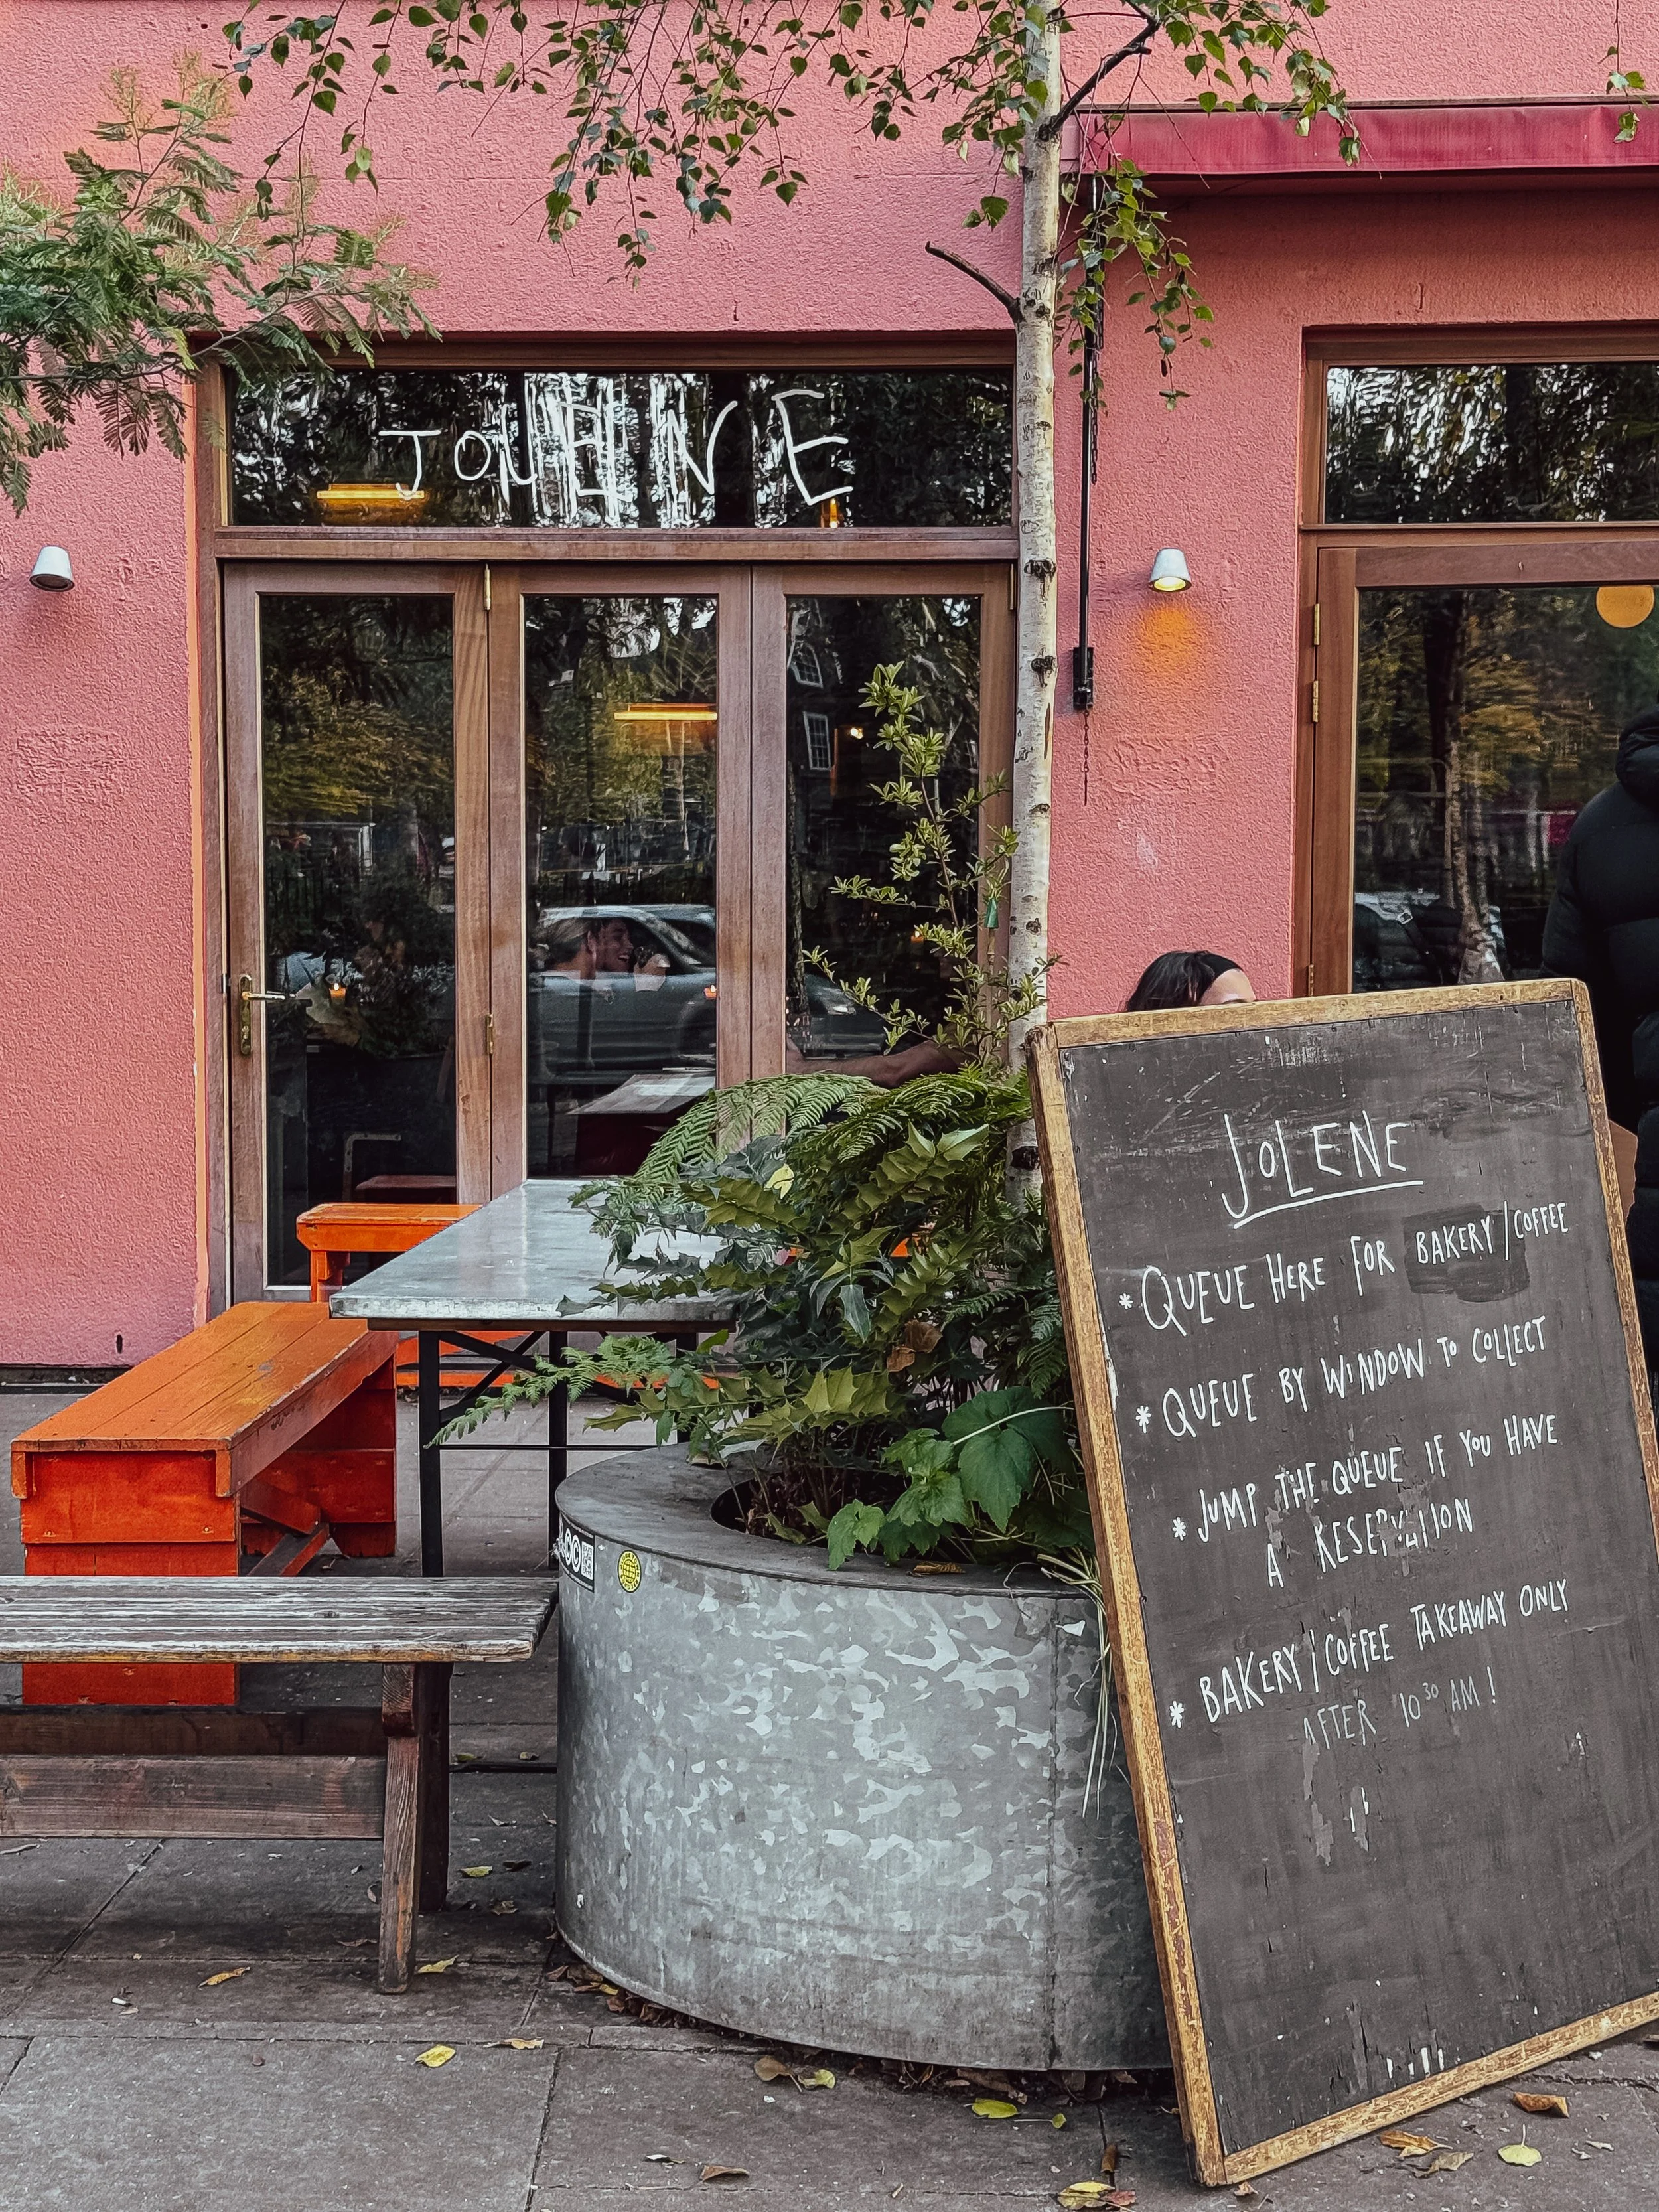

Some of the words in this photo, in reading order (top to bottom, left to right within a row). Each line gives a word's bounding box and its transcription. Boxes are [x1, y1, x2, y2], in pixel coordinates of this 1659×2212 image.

[1221, 1110, 1409, 1218] JOLENE
[1140, 1264, 1255, 1337] QUEUE
[1265, 1252, 1325, 1303] HERE
[1350, 1236, 1396, 1296] FOR
[1163, 1373, 1258, 1438] QUEUE
[1278, 1366, 1307, 1412] BY
[1320, 1338, 1425, 1399] WINDOW
[1436, 1336, 1457, 1368] TO
[1472, 1315, 1546, 1367] COLLECT
[1198, 1483, 1257, 1542] JUMP
[1274, 1462, 1320, 1510] THE
[1332, 1447, 1404, 1495] QUEUE
[1425, 1434, 1445, 1477] IF
[1459, 1429, 1491, 1467] YOU
[1503, 1414, 1557, 1456] HAVE
[1267, 1543, 1284, 1588] A
[1409, 1591, 1507, 1651] TAKEAWAY
[1520, 1578, 1568, 1617] ONLY
[1303, 1699, 1376, 1750] AFTER
